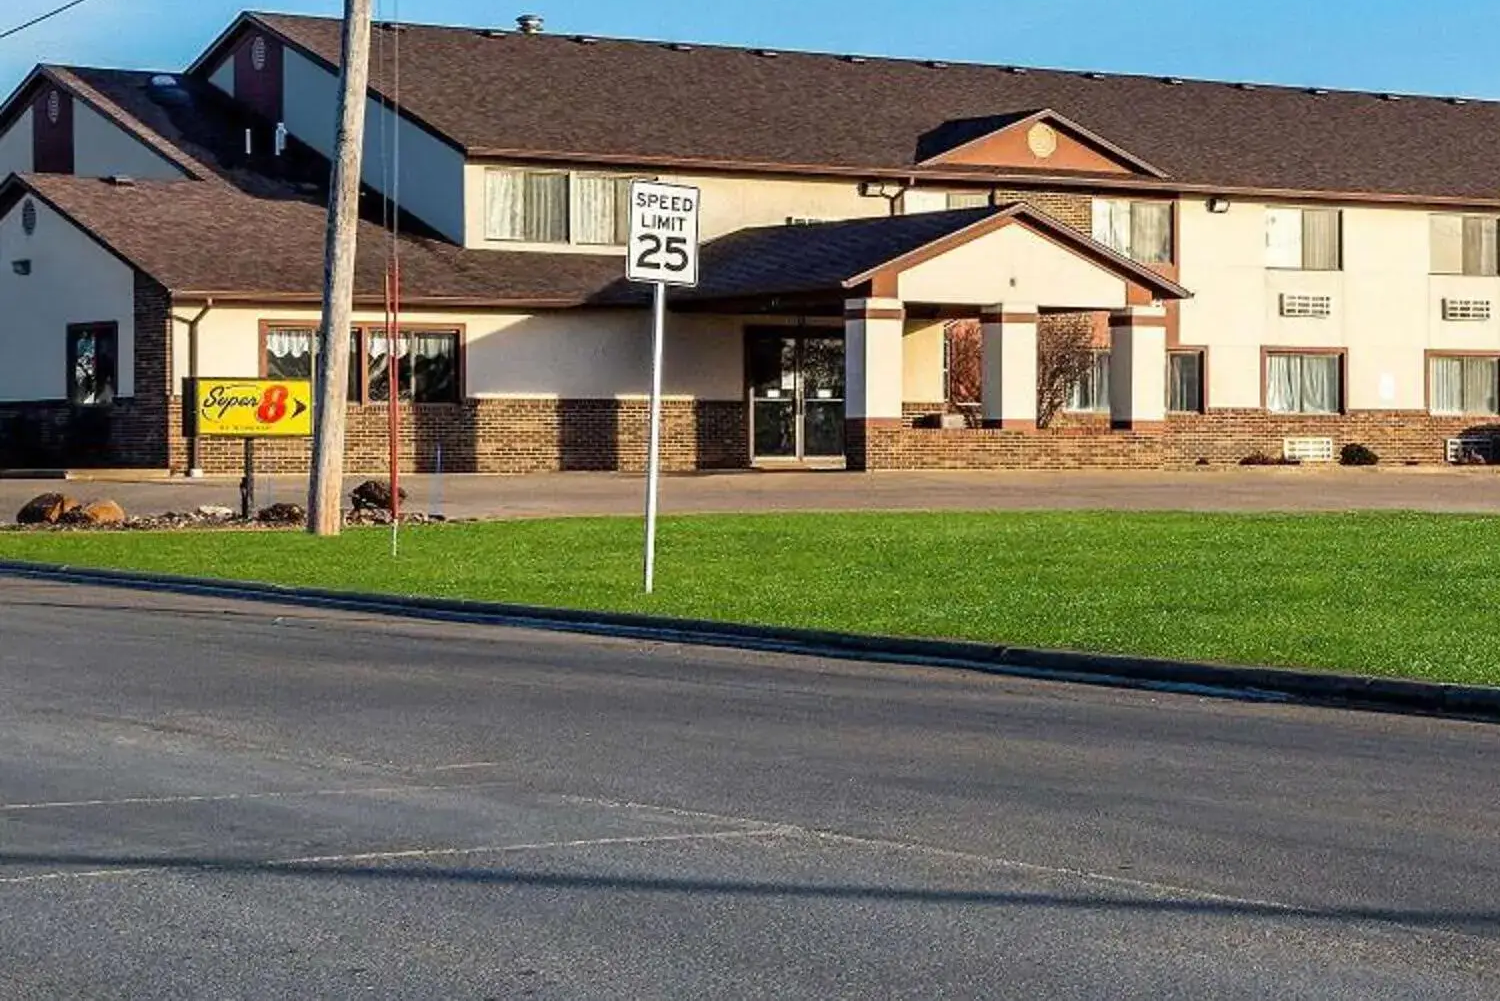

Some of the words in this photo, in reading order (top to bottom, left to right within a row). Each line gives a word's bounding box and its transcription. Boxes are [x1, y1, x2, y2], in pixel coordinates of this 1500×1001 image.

[636, 192, 693, 212] SPEED
[641, 213, 688, 232] LIMIT
[636, 233, 689, 272] 25
[203, 385, 258, 419] Super
[254, 384, 289, 424] 8
